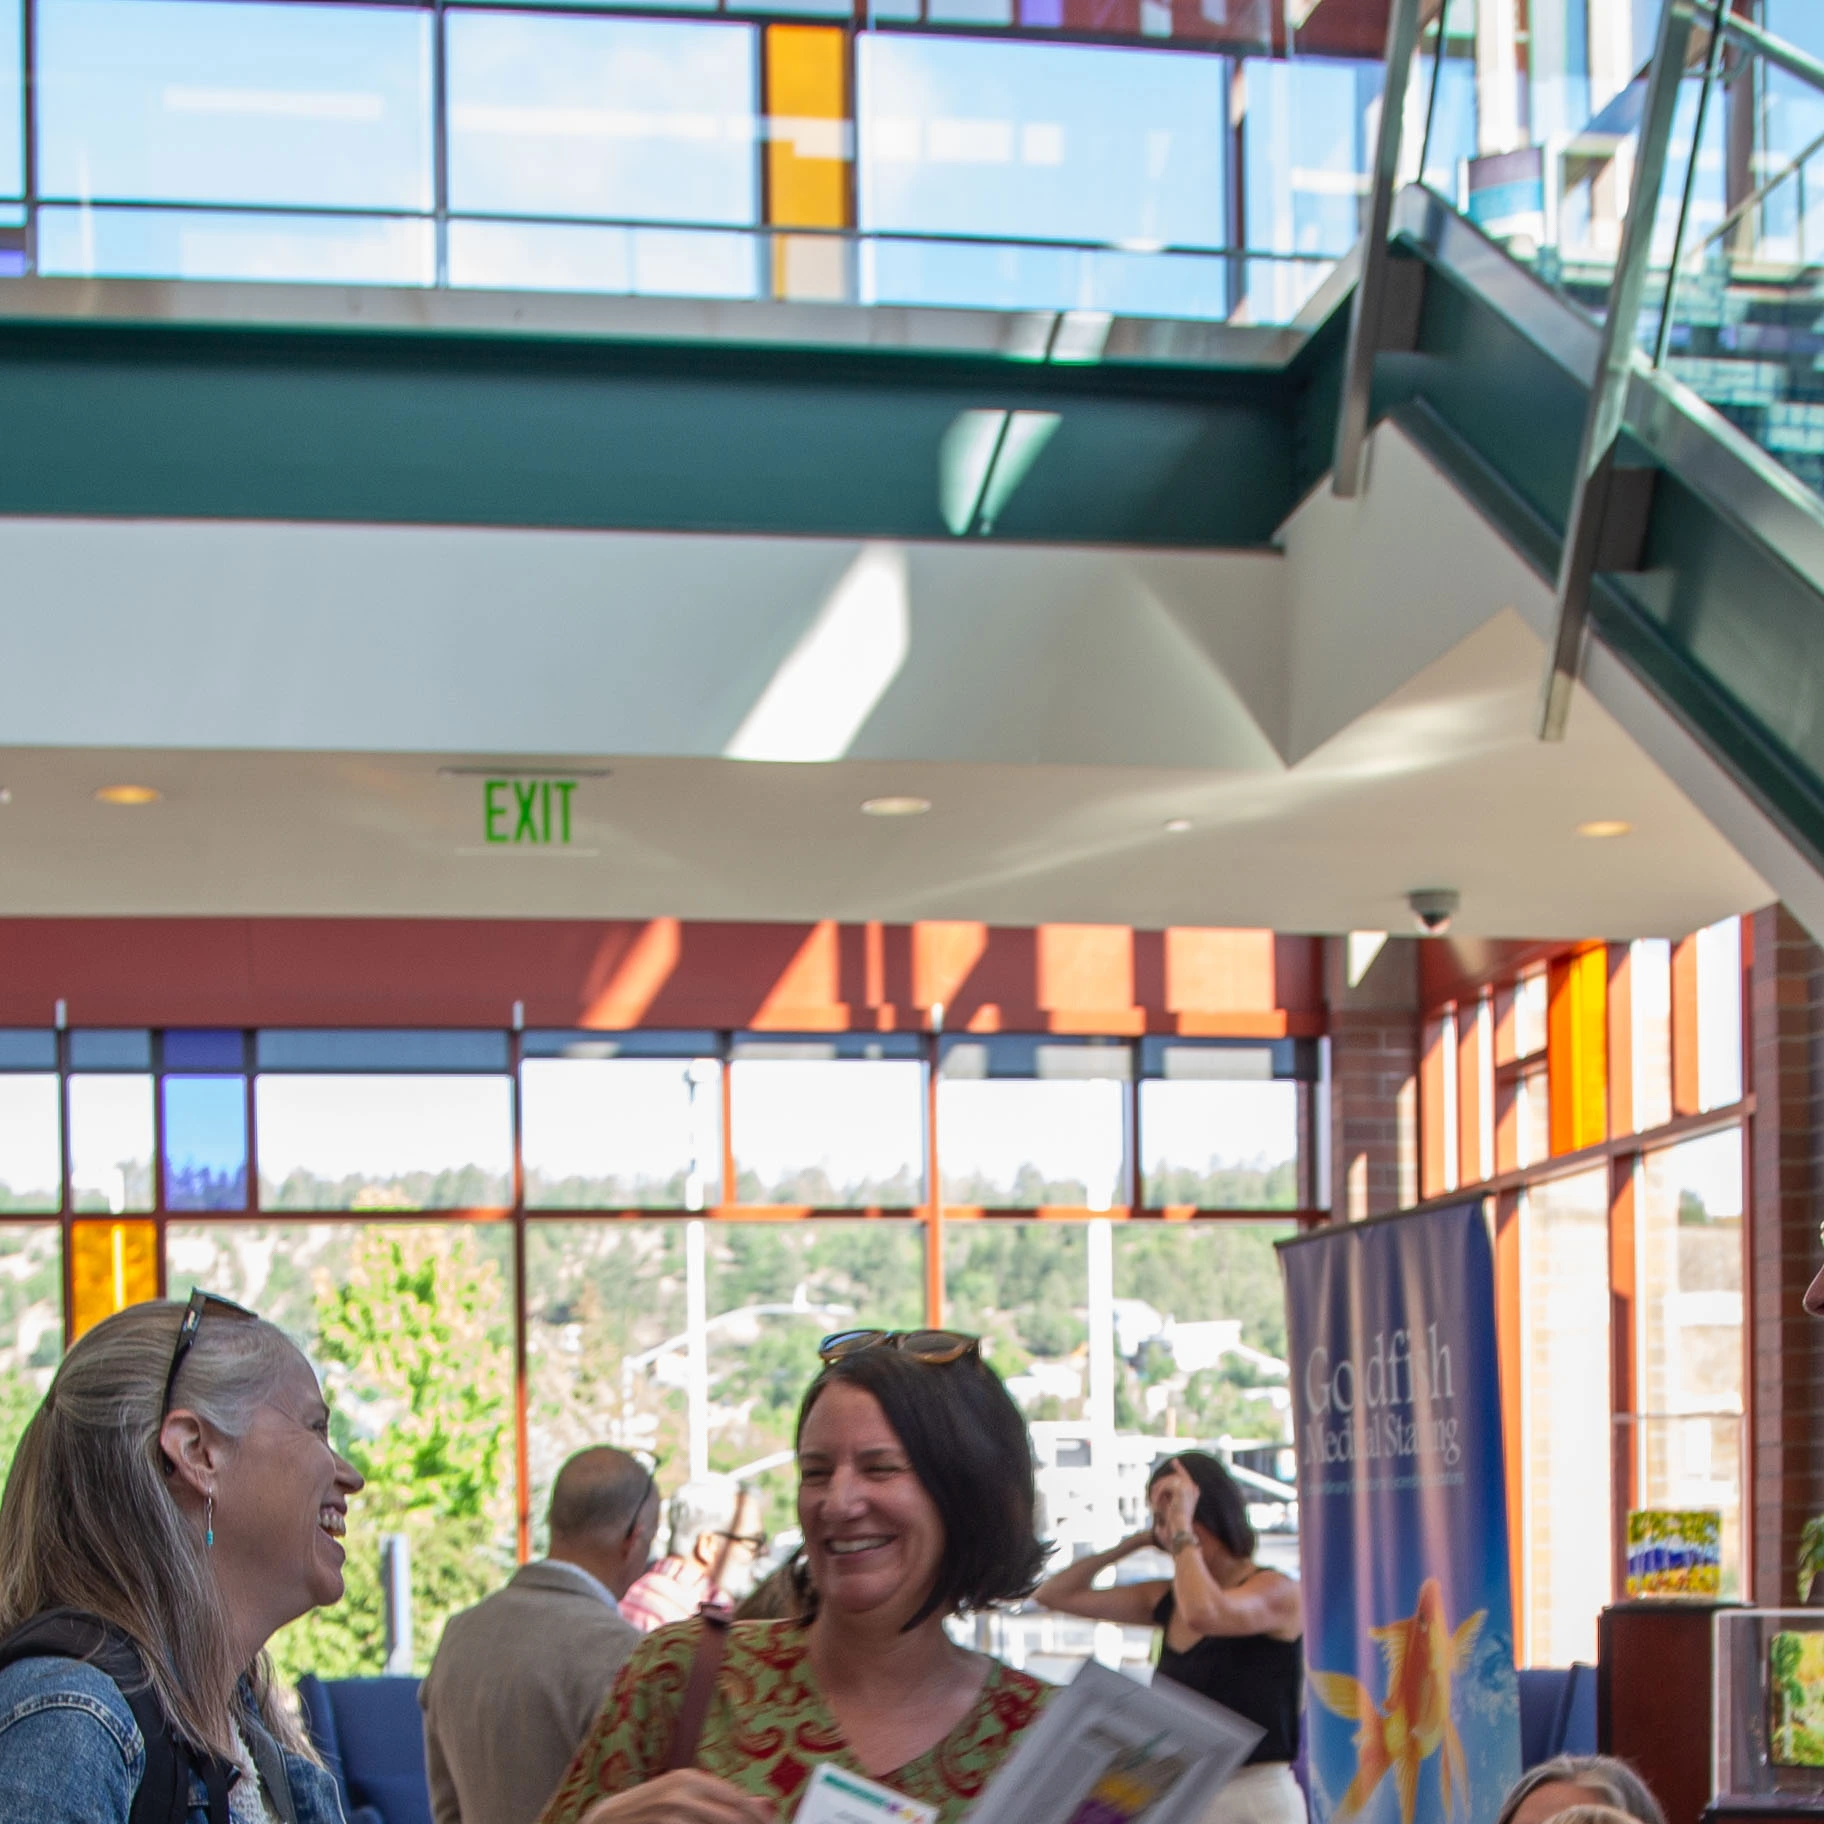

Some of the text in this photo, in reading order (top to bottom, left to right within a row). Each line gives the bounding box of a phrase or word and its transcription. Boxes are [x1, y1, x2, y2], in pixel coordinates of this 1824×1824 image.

[484, 780, 577, 842] EXIT
[1306, 1322, 1455, 1415] Godfish
[1304, 1412, 1461, 1465] Medal Stang
